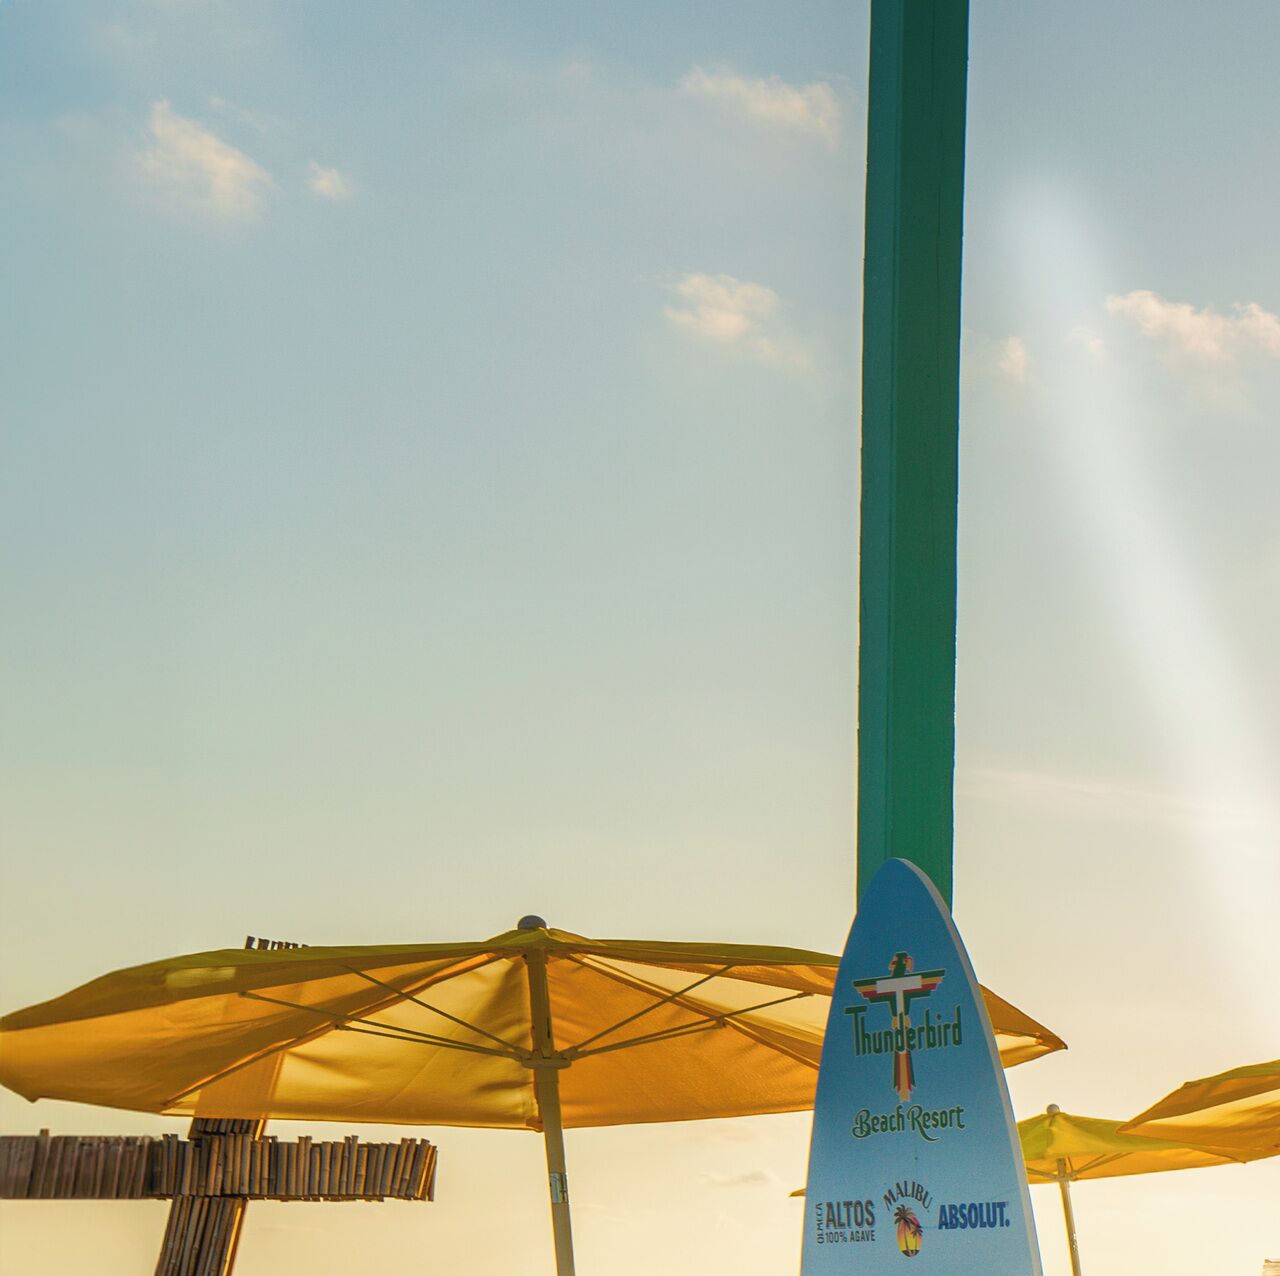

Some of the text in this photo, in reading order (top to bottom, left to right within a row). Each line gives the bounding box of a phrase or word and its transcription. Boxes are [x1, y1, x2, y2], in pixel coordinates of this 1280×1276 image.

[844, 1005, 962, 1056] Thunderbird
[852, 1105, 965, 1142] Beach Resort
[882, 1180, 932, 1211] MALIBU
[826, 1200, 875, 1229] ALTOS
[825, 1229, 876, 1244] 100% AGAVE
